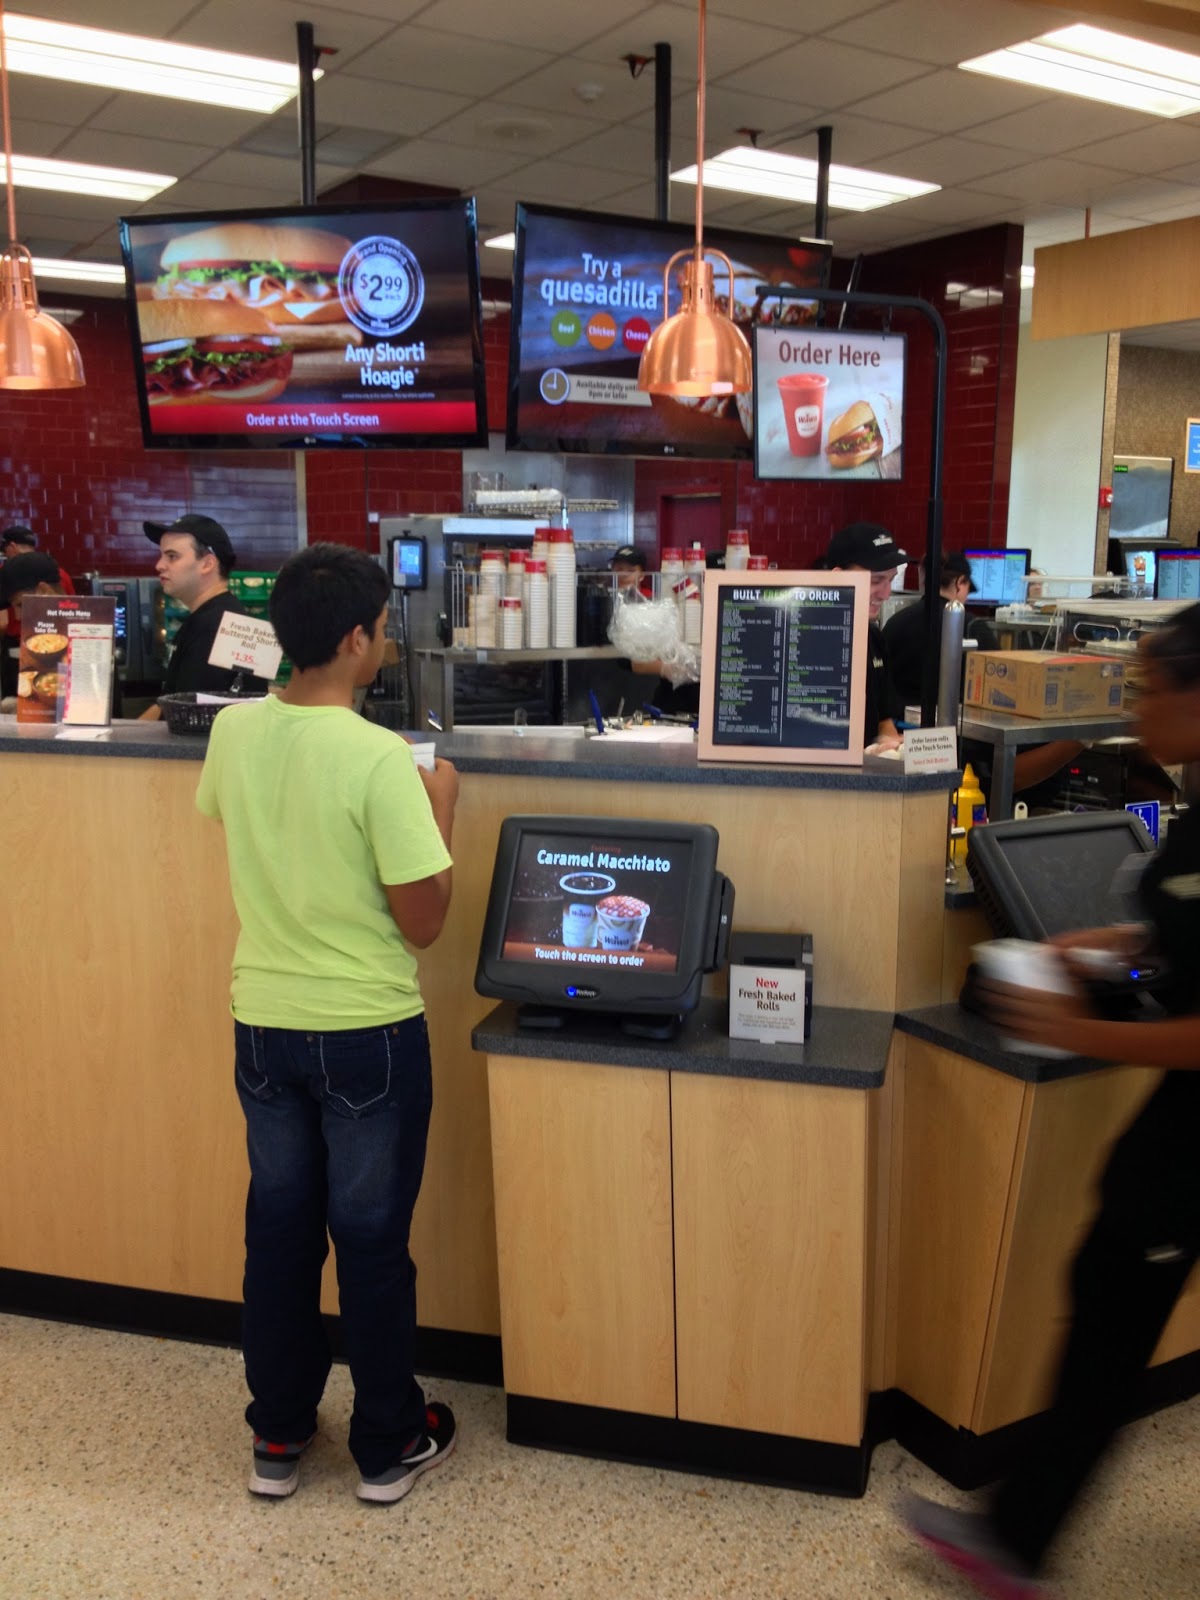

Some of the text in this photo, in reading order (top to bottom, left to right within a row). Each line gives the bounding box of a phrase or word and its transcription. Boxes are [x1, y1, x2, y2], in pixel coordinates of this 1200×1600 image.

[582, 253, 622, 282] Try a
[541, 278, 658, 310] quesadilla
[558, 323, 649, 341] Beef Chicken Cheese
[345, 340, 425, 366] Any Shorti
[779, 340, 881, 367] Order Here
[576, 379, 607, 389] Available
[608, 382, 624, 391] daily
[612, 391, 628, 400] later
[246, 412, 380, 426] Order at the Touch Screen
[733, 589, 761, 600] BUILT
[794, 590, 806, 600] TO
[809, 590, 840, 601] ORDER
[76, 610, 91, 618] Menu
[37, 621, 55, 629] Please
[230, 621, 251, 632] Fresh
[220, 626, 255, 641] Buttered
[241, 640, 257, 650] Roll
[911, 736, 924, 744] Order
[922, 744, 936, 752] Touch
[537, 849, 671, 872] Caramel Macchiato
[535, 947, 644, 966] Touch the screen to order
[755, 977, 779, 989] New
[738, 987, 796, 1001] Fresh Baked
[756, 1000, 780, 1011] Rolls
